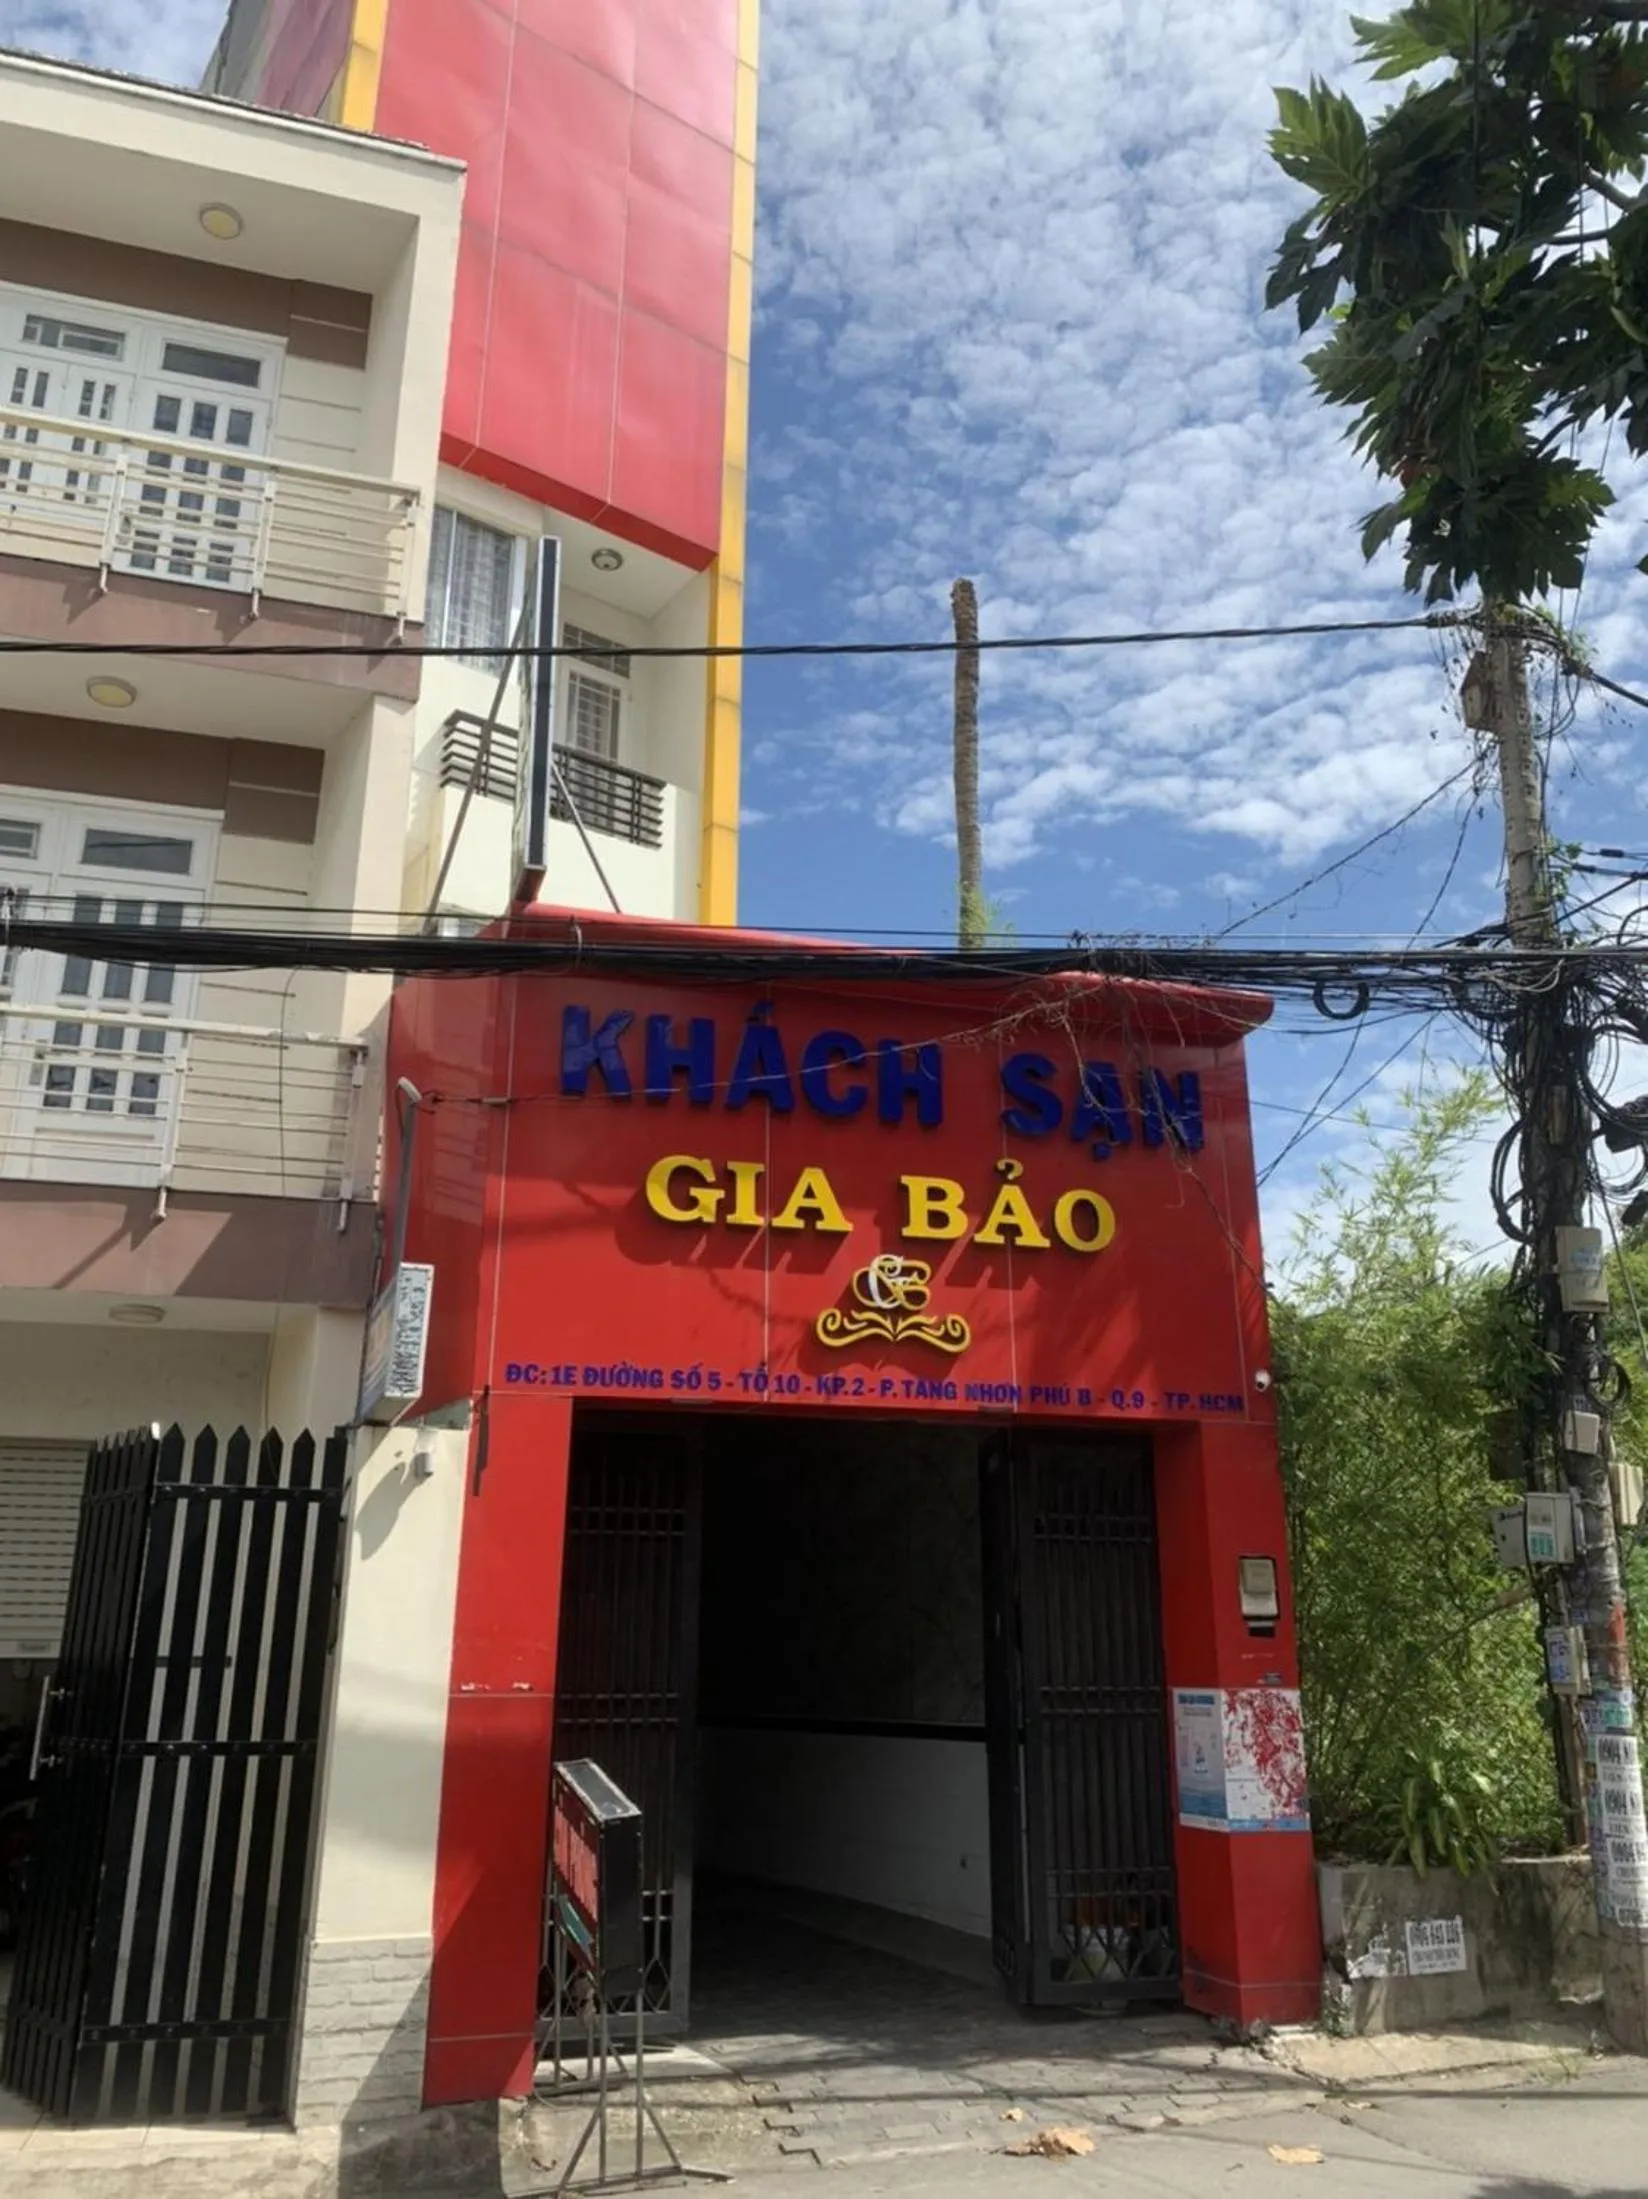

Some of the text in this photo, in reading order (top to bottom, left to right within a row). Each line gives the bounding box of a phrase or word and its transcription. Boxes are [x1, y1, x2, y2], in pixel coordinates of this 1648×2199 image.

[561, 1000, 1204, 1161] KHÁCH SẠN
[645, 1155, 1116, 1252] GIA BẢO
[583, 1360, 664, 1389] ĐƯỜNG
[671, 1361, 703, 1390] SỐ
[707, 1372, 722, 1391] 5
[774, 1375, 799, 1394] 10
